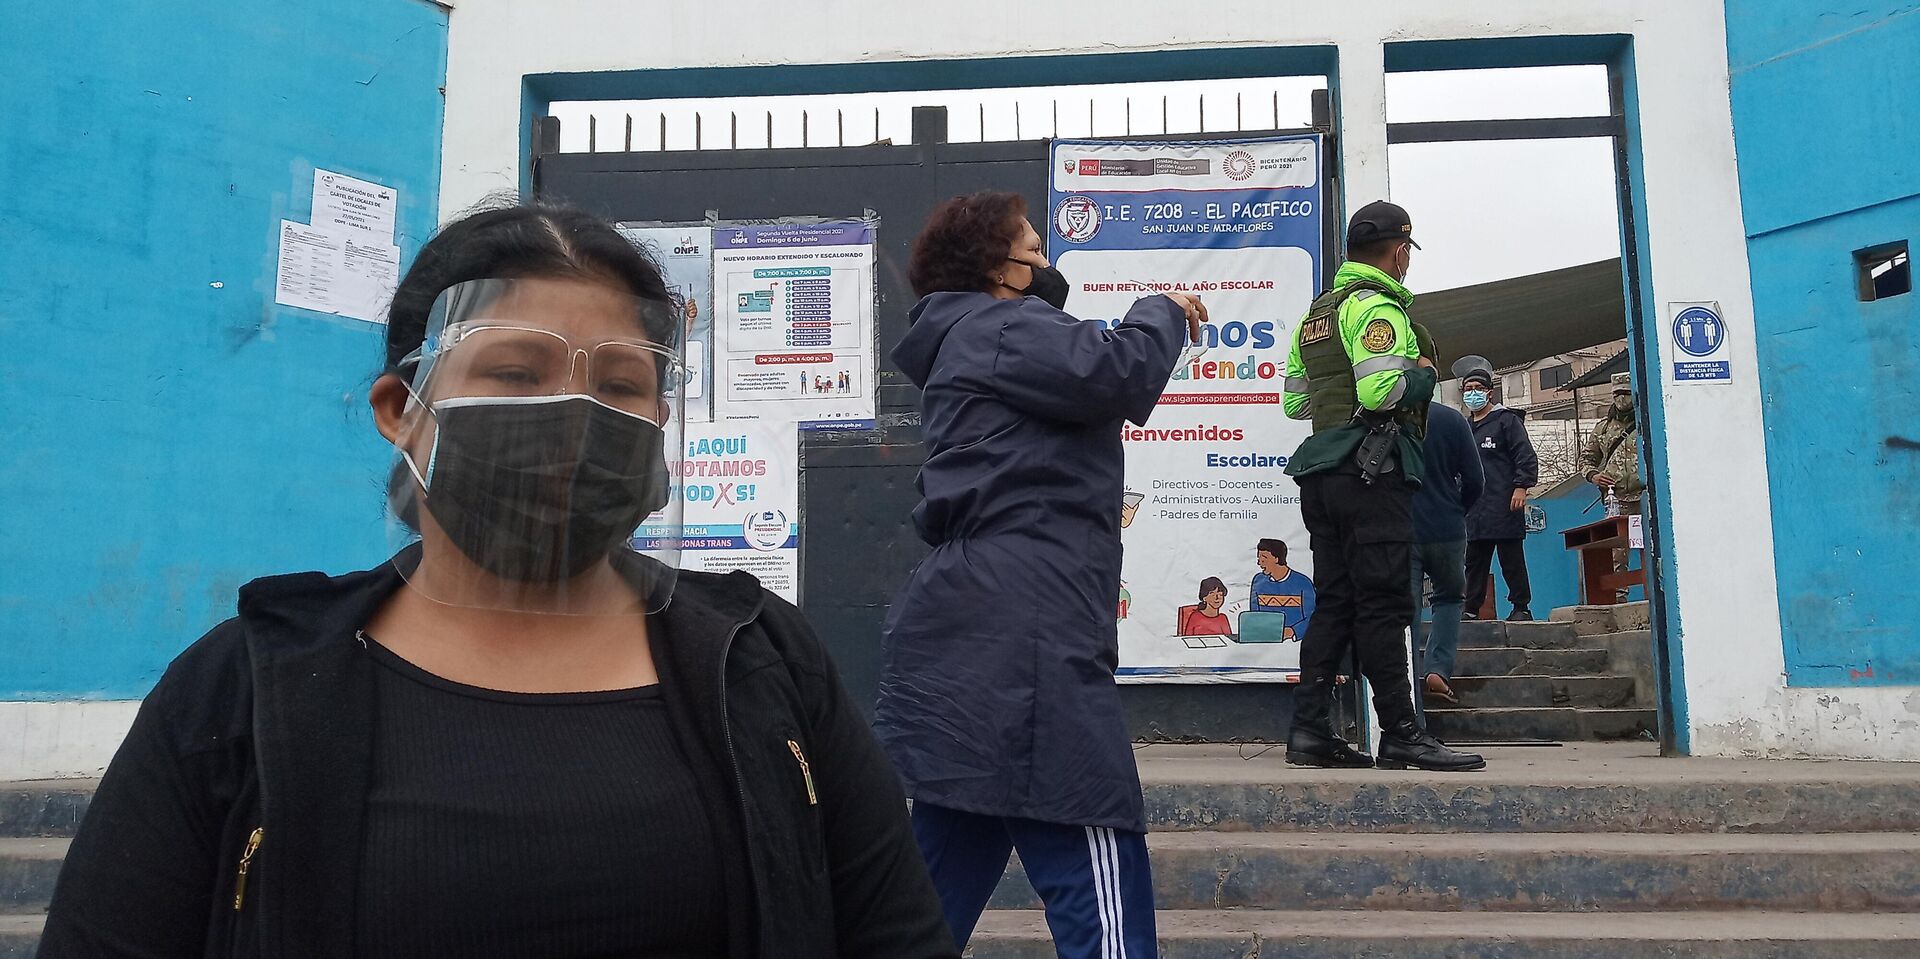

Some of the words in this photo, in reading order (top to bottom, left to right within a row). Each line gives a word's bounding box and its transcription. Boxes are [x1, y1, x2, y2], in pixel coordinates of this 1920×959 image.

[330, 191, 346, 199] CARTEL
[355, 197, 374, 205] LOCALES
[342, 201, 366, 210] VOTACIÓN
[1104, 205, 1136, 221] I.E.
[1144, 203, 1183, 220] 7208
[1206, 204, 1226, 220] EL
[1232, 201, 1312, 218] PACIFICO
[1142, 225, 1162, 233] SAN
[1166, 224, 1194, 233] JUAN
[1197, 224, 1209, 232] DE
[1212, 222, 1274, 232] MIRAFLORES
[674, 246, 699, 254] ONPE
[1116, 283, 1171, 291] RETORNO
[1173, 283, 1189, 291] AL
[1193, 280, 1217, 291] AÑO
[1220, 281, 1274, 290] ESCOLAR
[1303, 317, 1330, 342] POLICIA
[1171, 355, 1276, 380] diendo
[1158, 395, 1277, 403] ww.sigamosaprendiendo.pe
[1119, 424, 1243, 441] ienvenidos
[689, 435, 746, 457] ¡AQUÍ
[1207, 453, 1291, 467] Escolare
[1152, 480, 1208, 489] Directivos
[1219, 480, 1272, 489] Docentes
[1152, 495, 1241, 504] Administrativos
[1252, 495, 1301, 504] Auxiliare
[1160, 510, 1199, 519] Padres
[1203, 510, 1216, 519] de
[1219, 510, 1258, 520] familia
[685, 528, 708, 536] HACIA
[647, 540, 659, 548] LAS
[708, 539, 731, 547] TRANS
